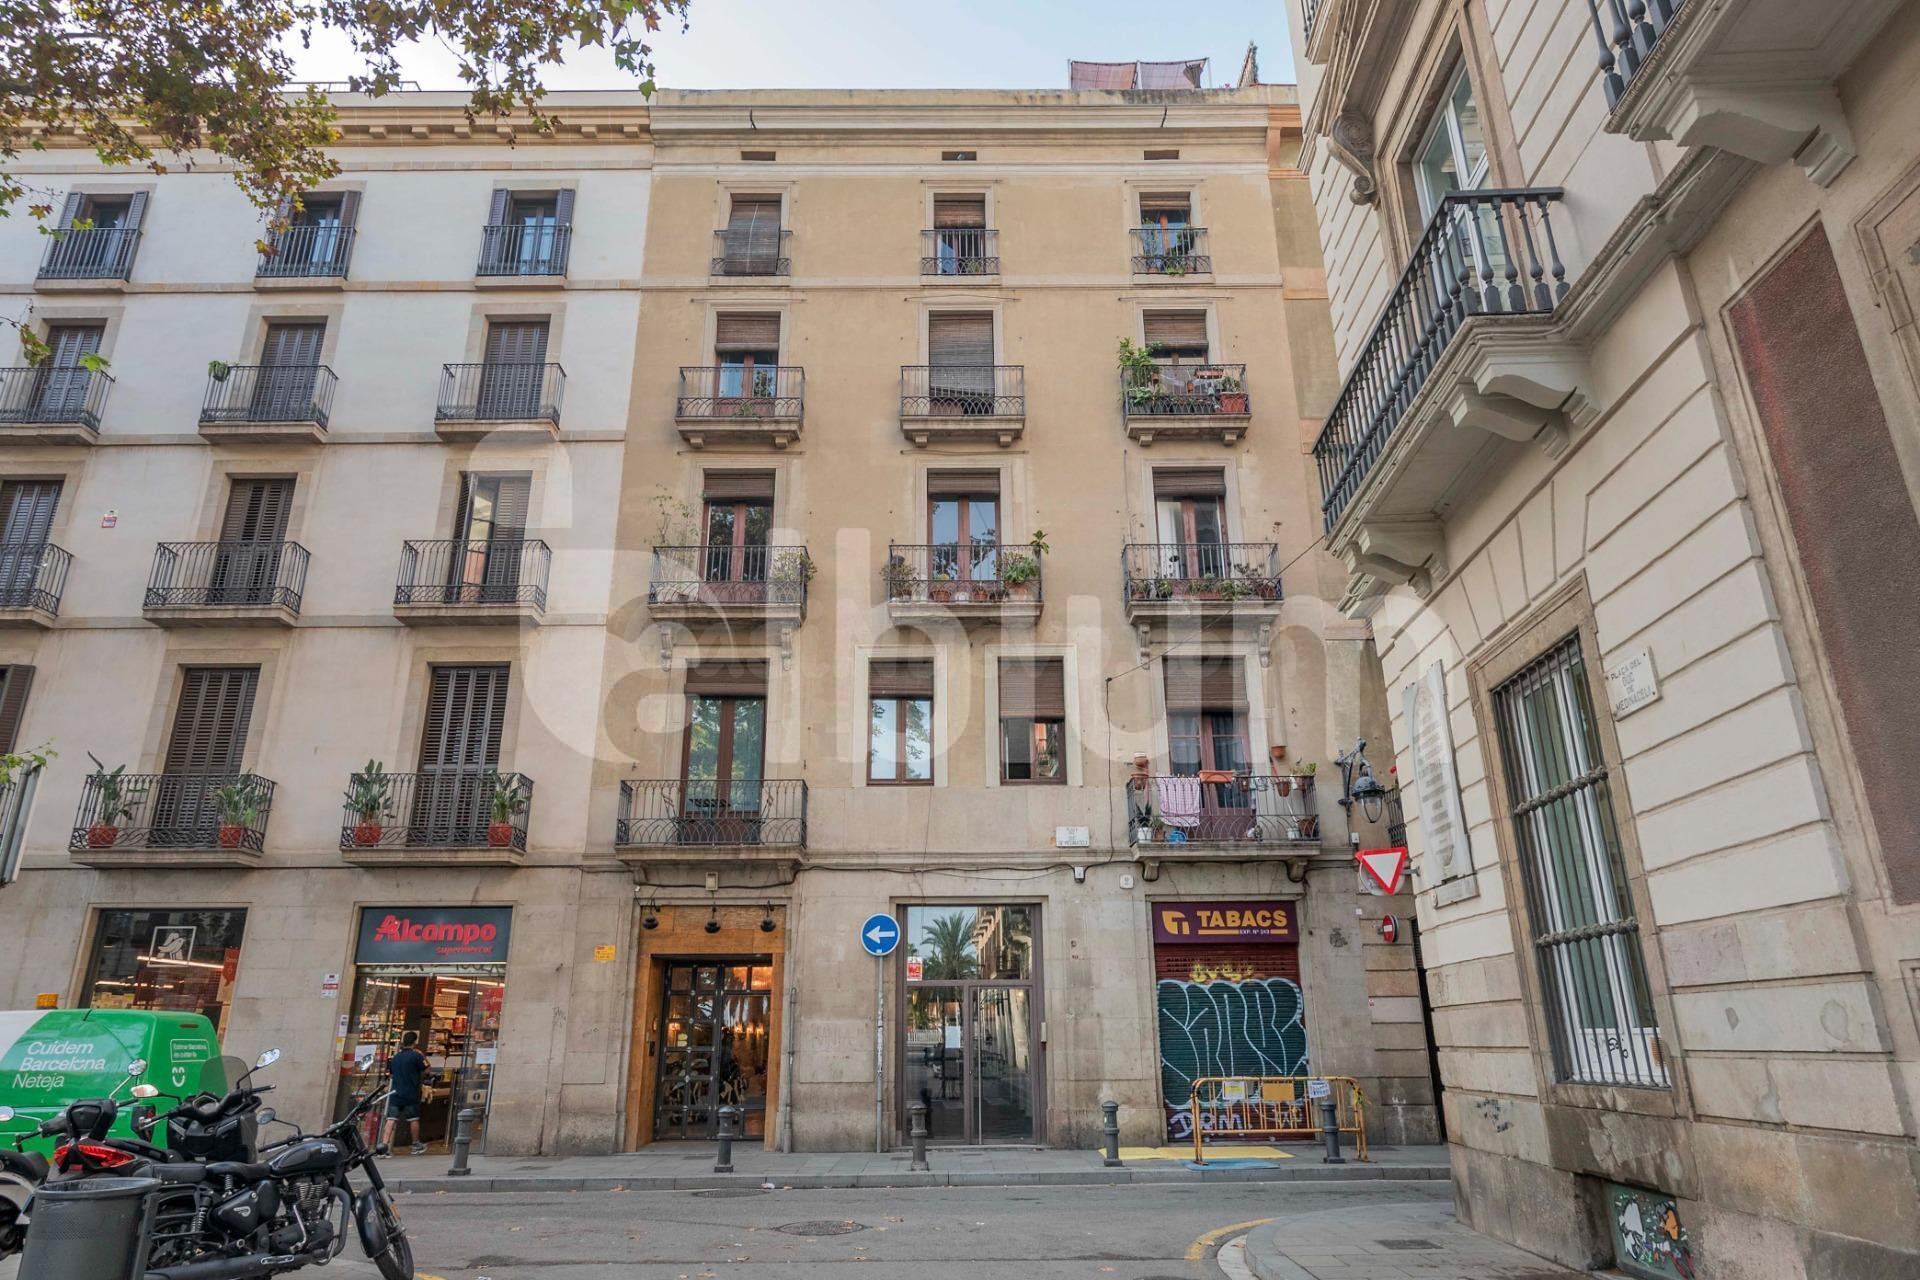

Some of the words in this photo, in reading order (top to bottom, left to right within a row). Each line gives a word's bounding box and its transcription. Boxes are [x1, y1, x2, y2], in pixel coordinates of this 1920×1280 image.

[1196, 910, 1288, 928] TABACS
[374, 915, 497, 945] Alcampo
[27, 1040, 94, 1055] Cuidem
[19, 1057, 106, 1072] Barcelona
[12, 1073, 65, 1092] Neteja
